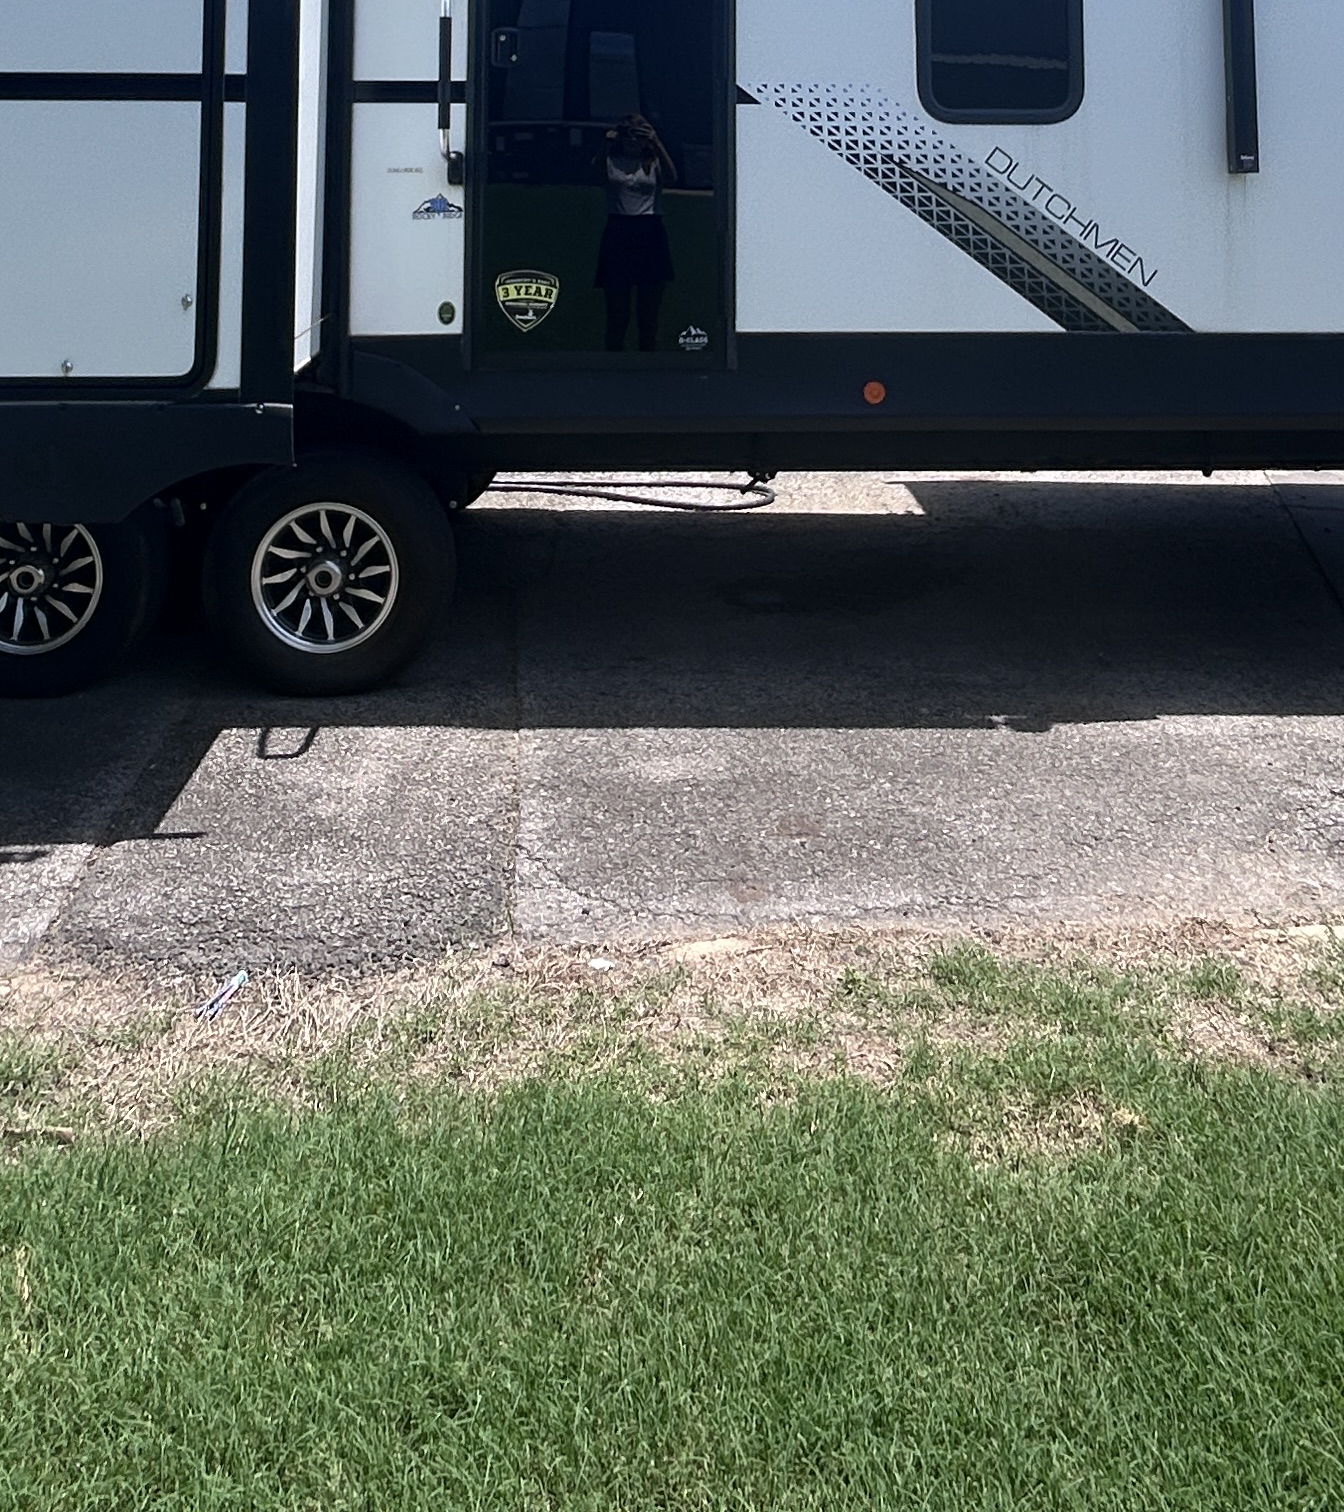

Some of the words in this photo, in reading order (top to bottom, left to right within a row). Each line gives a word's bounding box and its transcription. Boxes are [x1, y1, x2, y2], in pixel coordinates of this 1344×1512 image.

[984, 146, 1158, 287] DUTCHMEN
[502, 287, 509, 298] 3
[514, 285, 554, 300] YEAR
